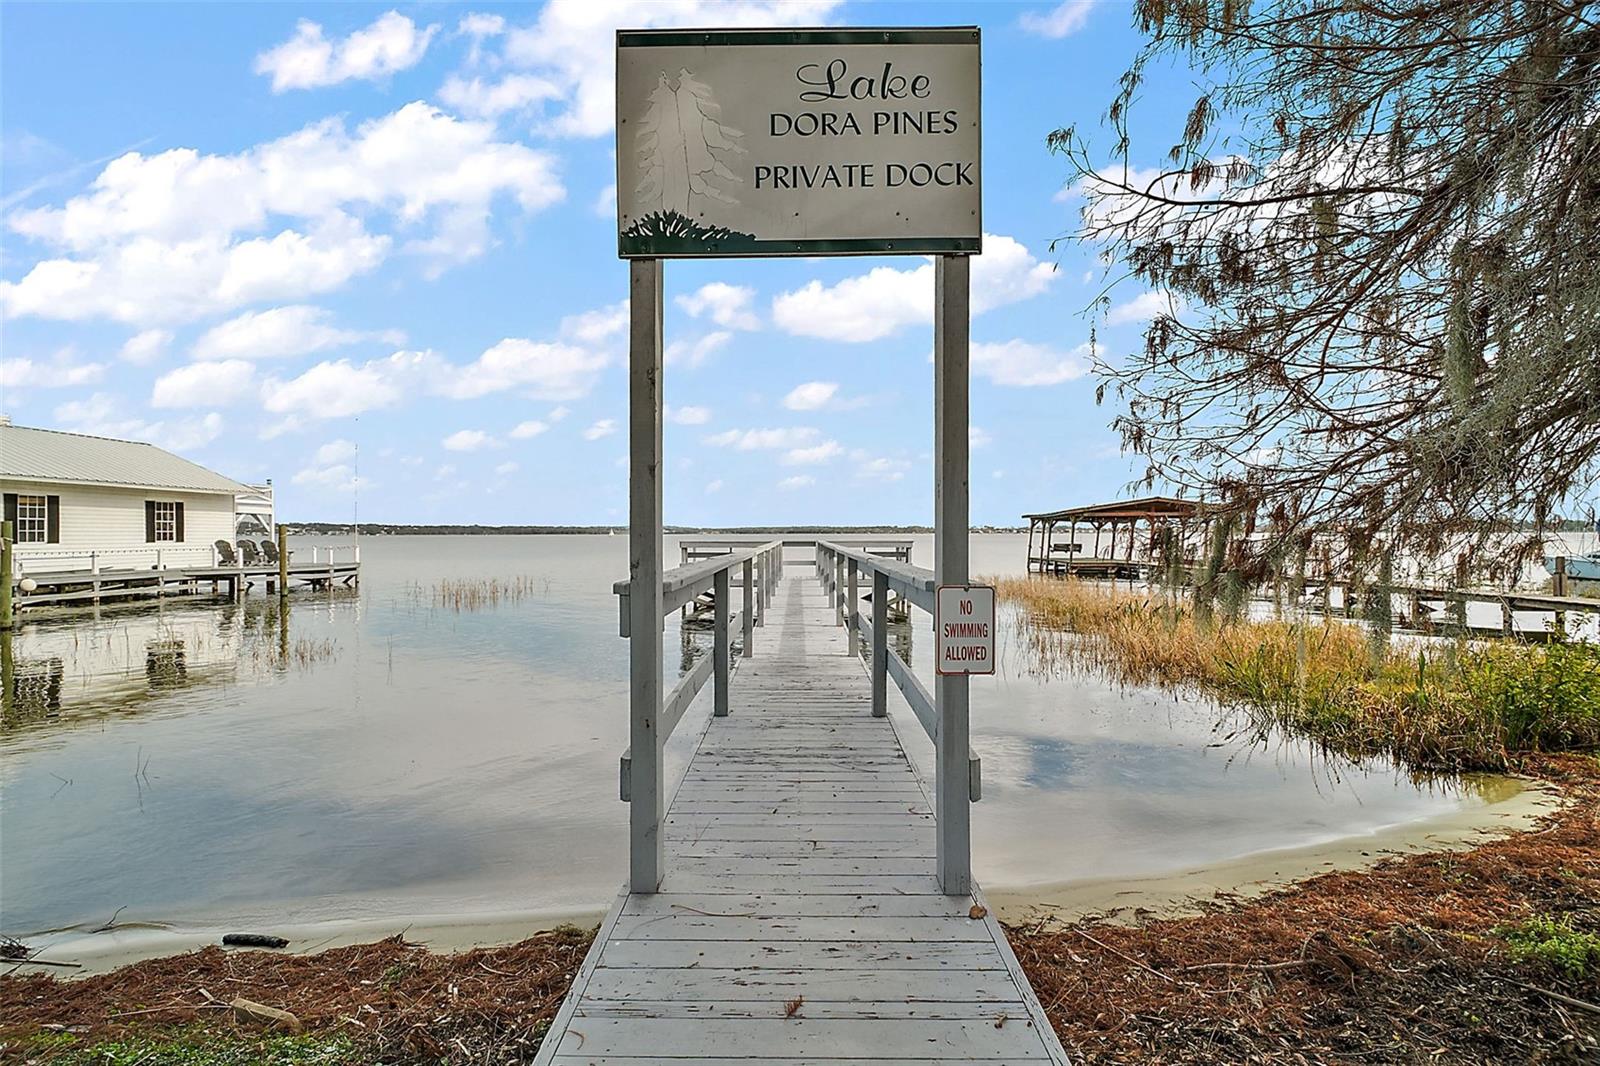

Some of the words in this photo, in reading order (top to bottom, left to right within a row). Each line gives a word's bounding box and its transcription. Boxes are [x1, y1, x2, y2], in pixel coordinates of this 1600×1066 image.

[796, 59, 931, 102] Lake
[769, 112, 861, 137] DORA
[873, 110, 958, 136] PINES
[755, 164, 874, 189] PRIVATE
[886, 162, 975, 187] DOCK
[960, 600, 972, 615] NO
[944, 623, 988, 638] SWIMMING
[945, 646, 987, 661] ALLOWED
